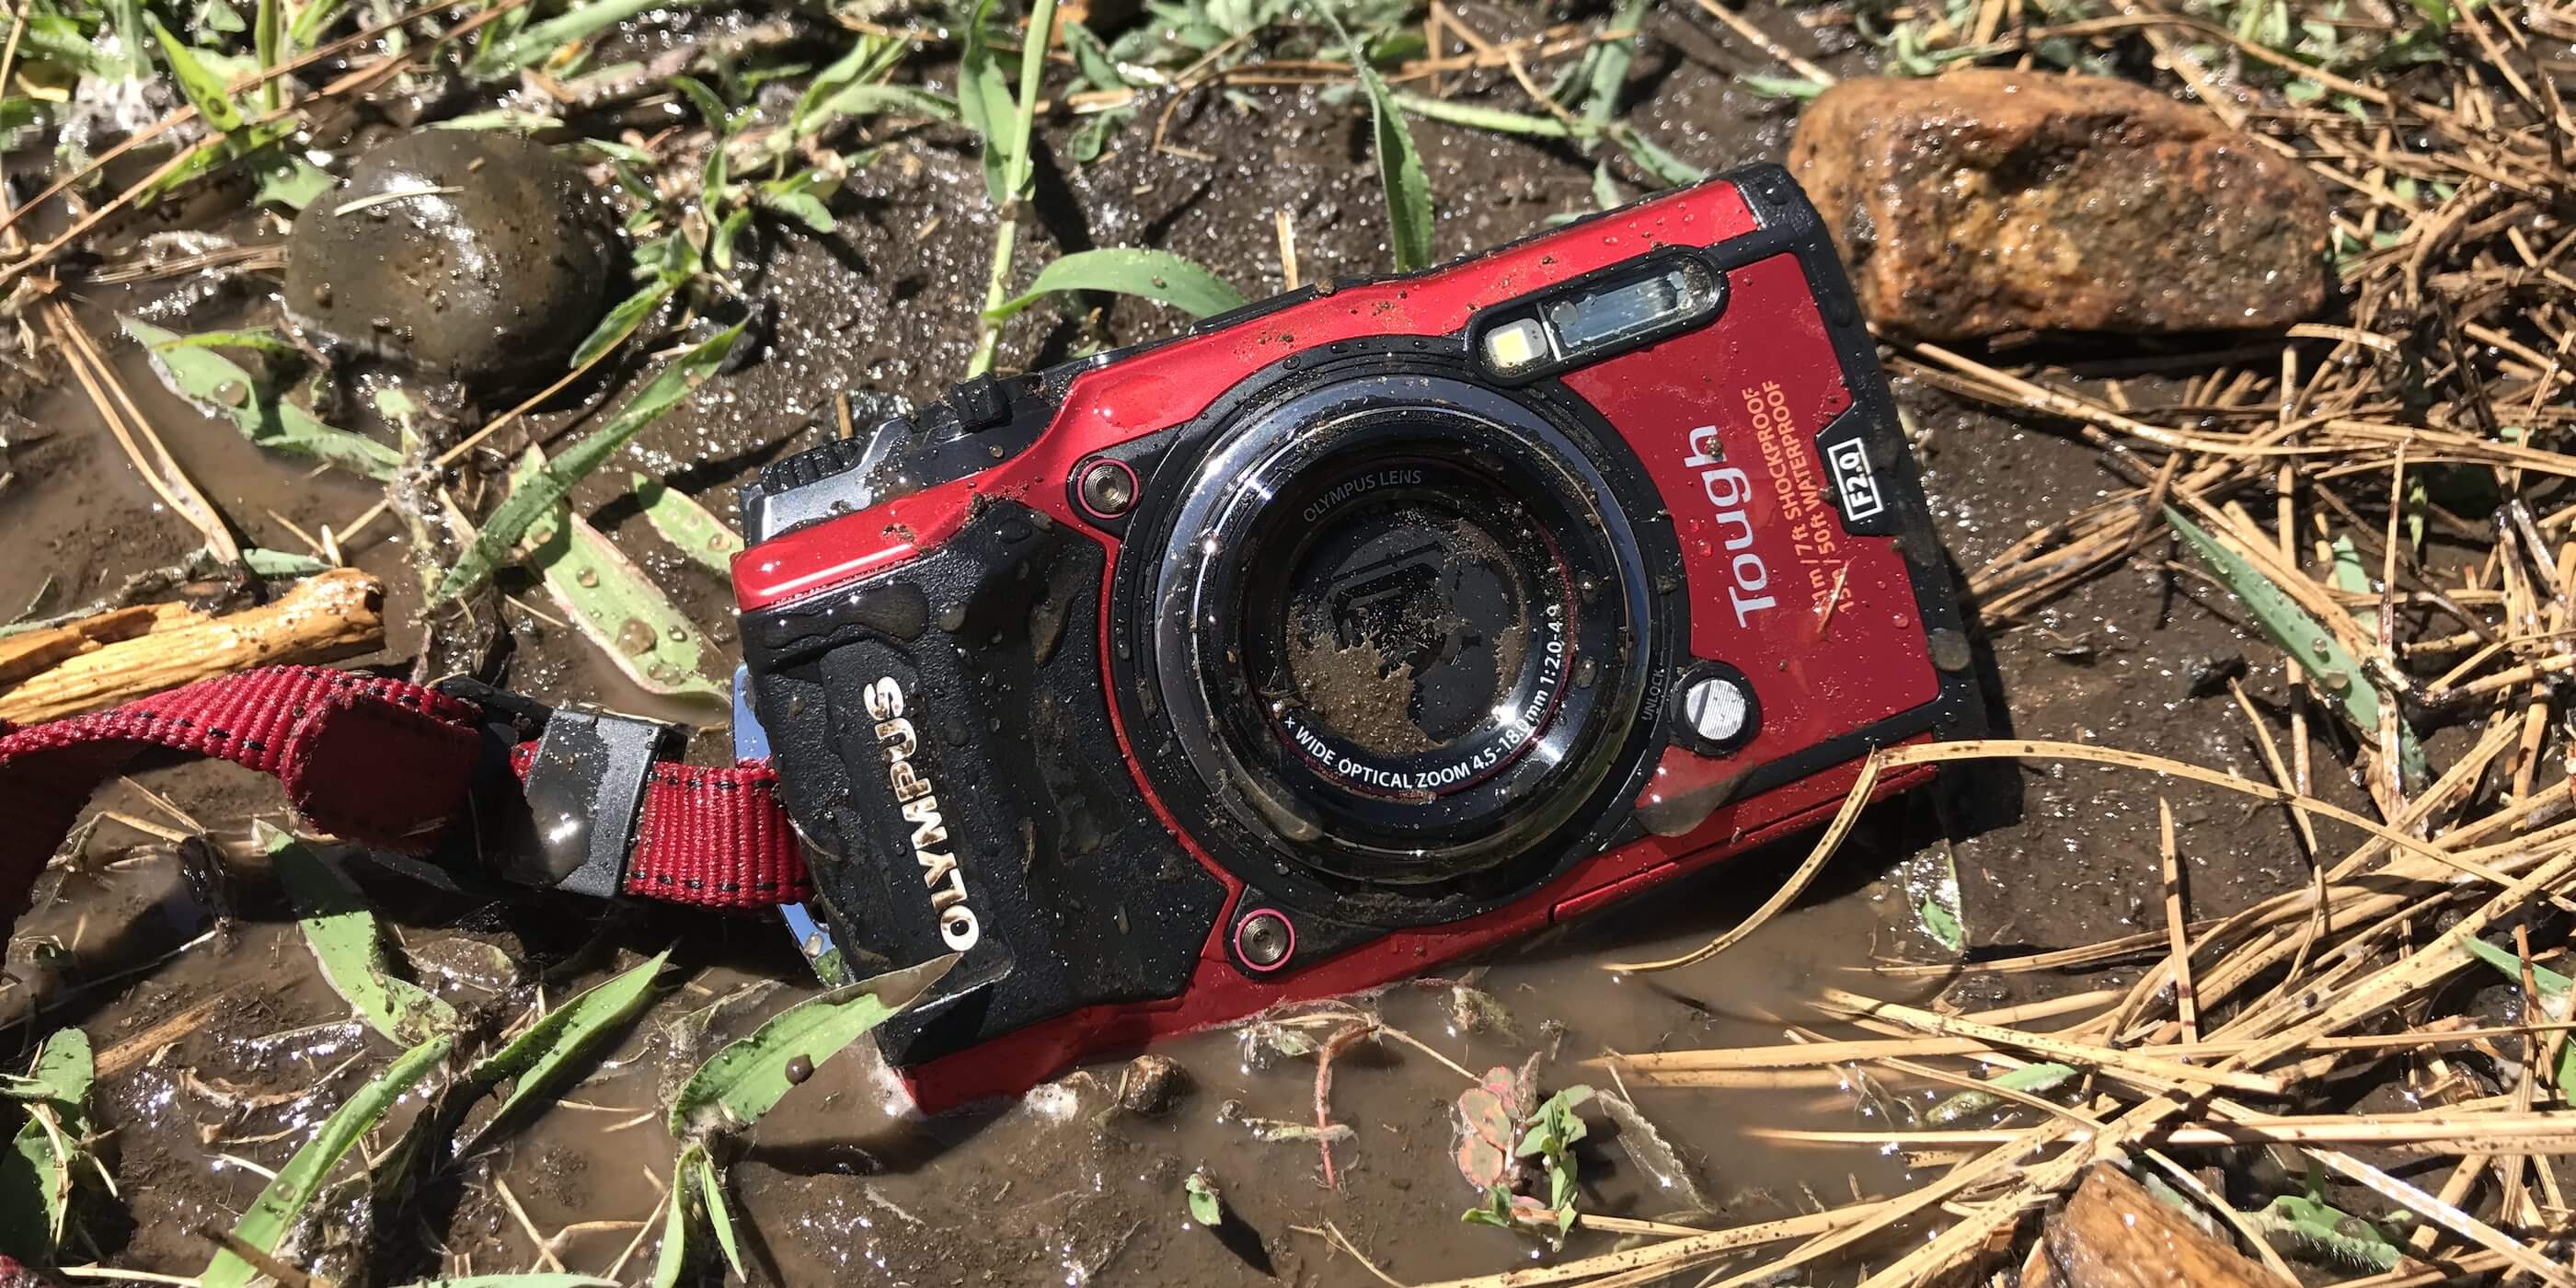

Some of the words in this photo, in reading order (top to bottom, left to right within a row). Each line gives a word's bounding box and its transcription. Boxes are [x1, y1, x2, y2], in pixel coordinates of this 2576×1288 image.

[1742, 387, 1802, 521] SHOCKPROOF
[1762, 380, 1821, 512] WATERPROOF
[1839, 452, 1872, 508] F2.0
[1303, 474, 1376, 523] OLYMPUS
[1380, 469, 1422, 487] LENS
[1684, 424, 1777, 629] Tough
[1640, 669, 1664, 720] UNLOCK
[1295, 725, 1337, 765] WIDE
[1338, 758, 1413, 788] OPTICAL
[1415, 762, 1471, 788] ZOOM
[863, 675, 980, 952] OLYMPUS
